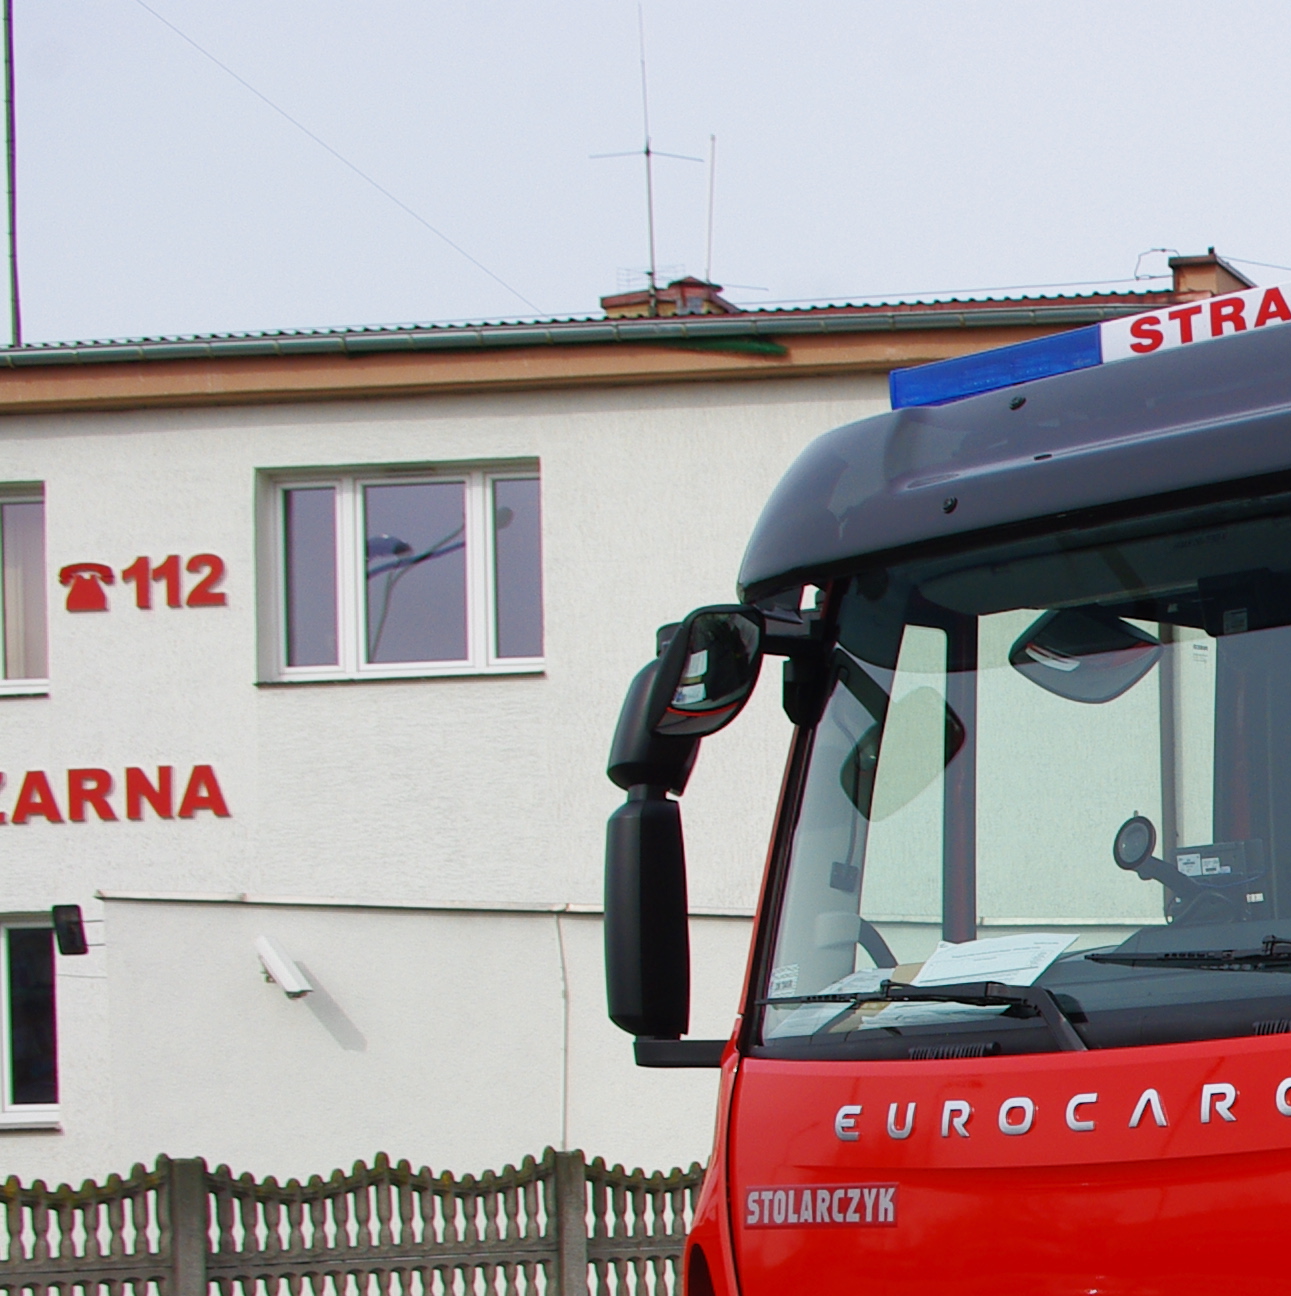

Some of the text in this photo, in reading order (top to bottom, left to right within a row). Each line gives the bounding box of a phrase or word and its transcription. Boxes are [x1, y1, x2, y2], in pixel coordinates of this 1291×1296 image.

[122, 553, 228, 610] 112
[0, 764, 232, 825] ARNA
[746, 1187, 896, 1224] STOLARCZYK
